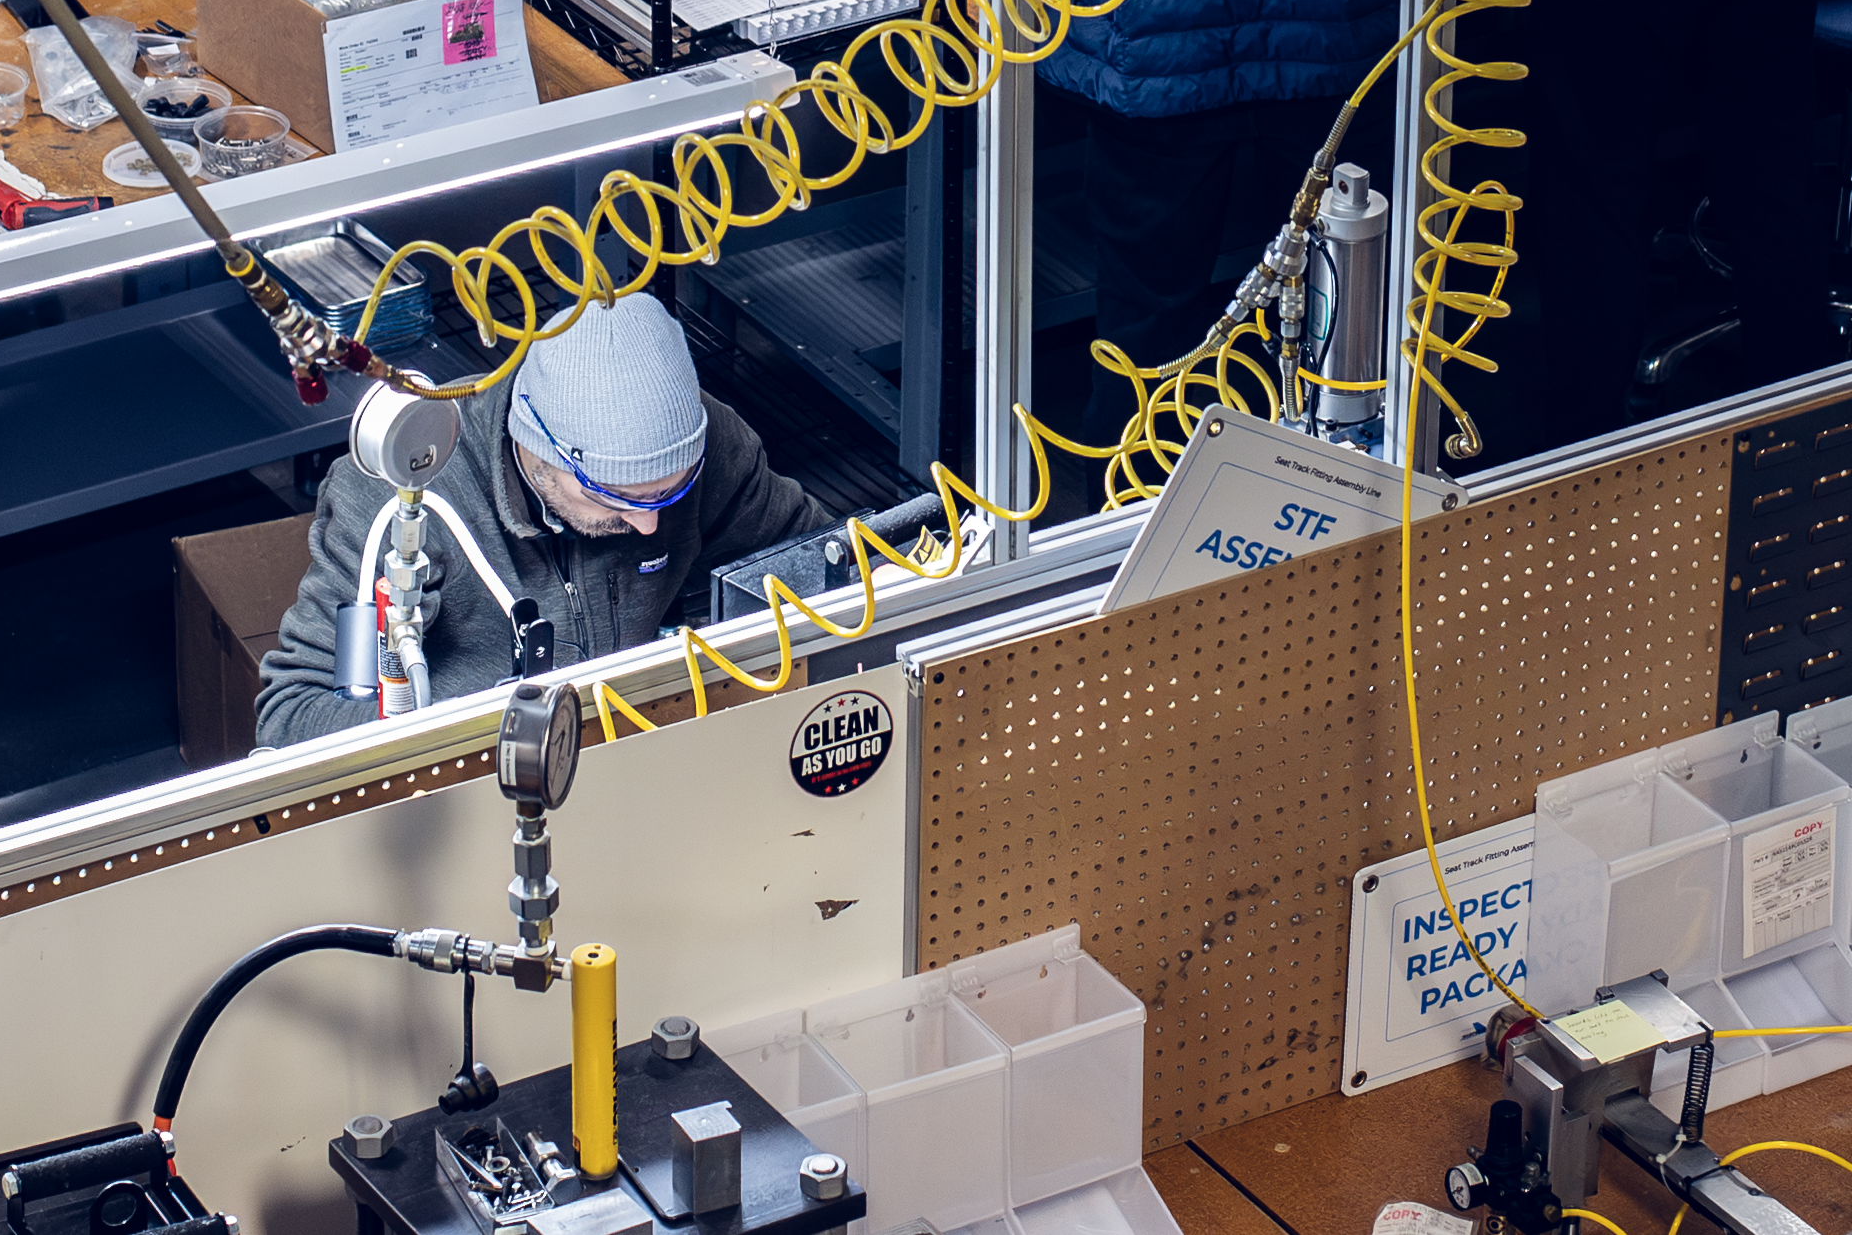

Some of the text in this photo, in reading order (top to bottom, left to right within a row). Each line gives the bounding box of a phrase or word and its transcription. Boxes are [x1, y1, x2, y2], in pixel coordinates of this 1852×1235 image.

[1275, 455, 1381, 498] Seat Track Fitting Assembly Line
[1273, 503, 1337, 540] STF
[1195, 529, 1293, 569] ASSE
[804, 705, 879, 751] CLEAN
[801, 753, 823, 776] AS
[826, 743, 856, 768] YOU
[860, 736, 882, 759] GO
[1794, 821, 1823, 838] COPY
[1444, 863, 1462, 875] Seat
[1463, 856, 1484, 870] Track
[1484, 848, 1510, 863] Fitting
[1406, 921, 1518, 981] READY
[1383, 1209, 1422, 1221] COPY
